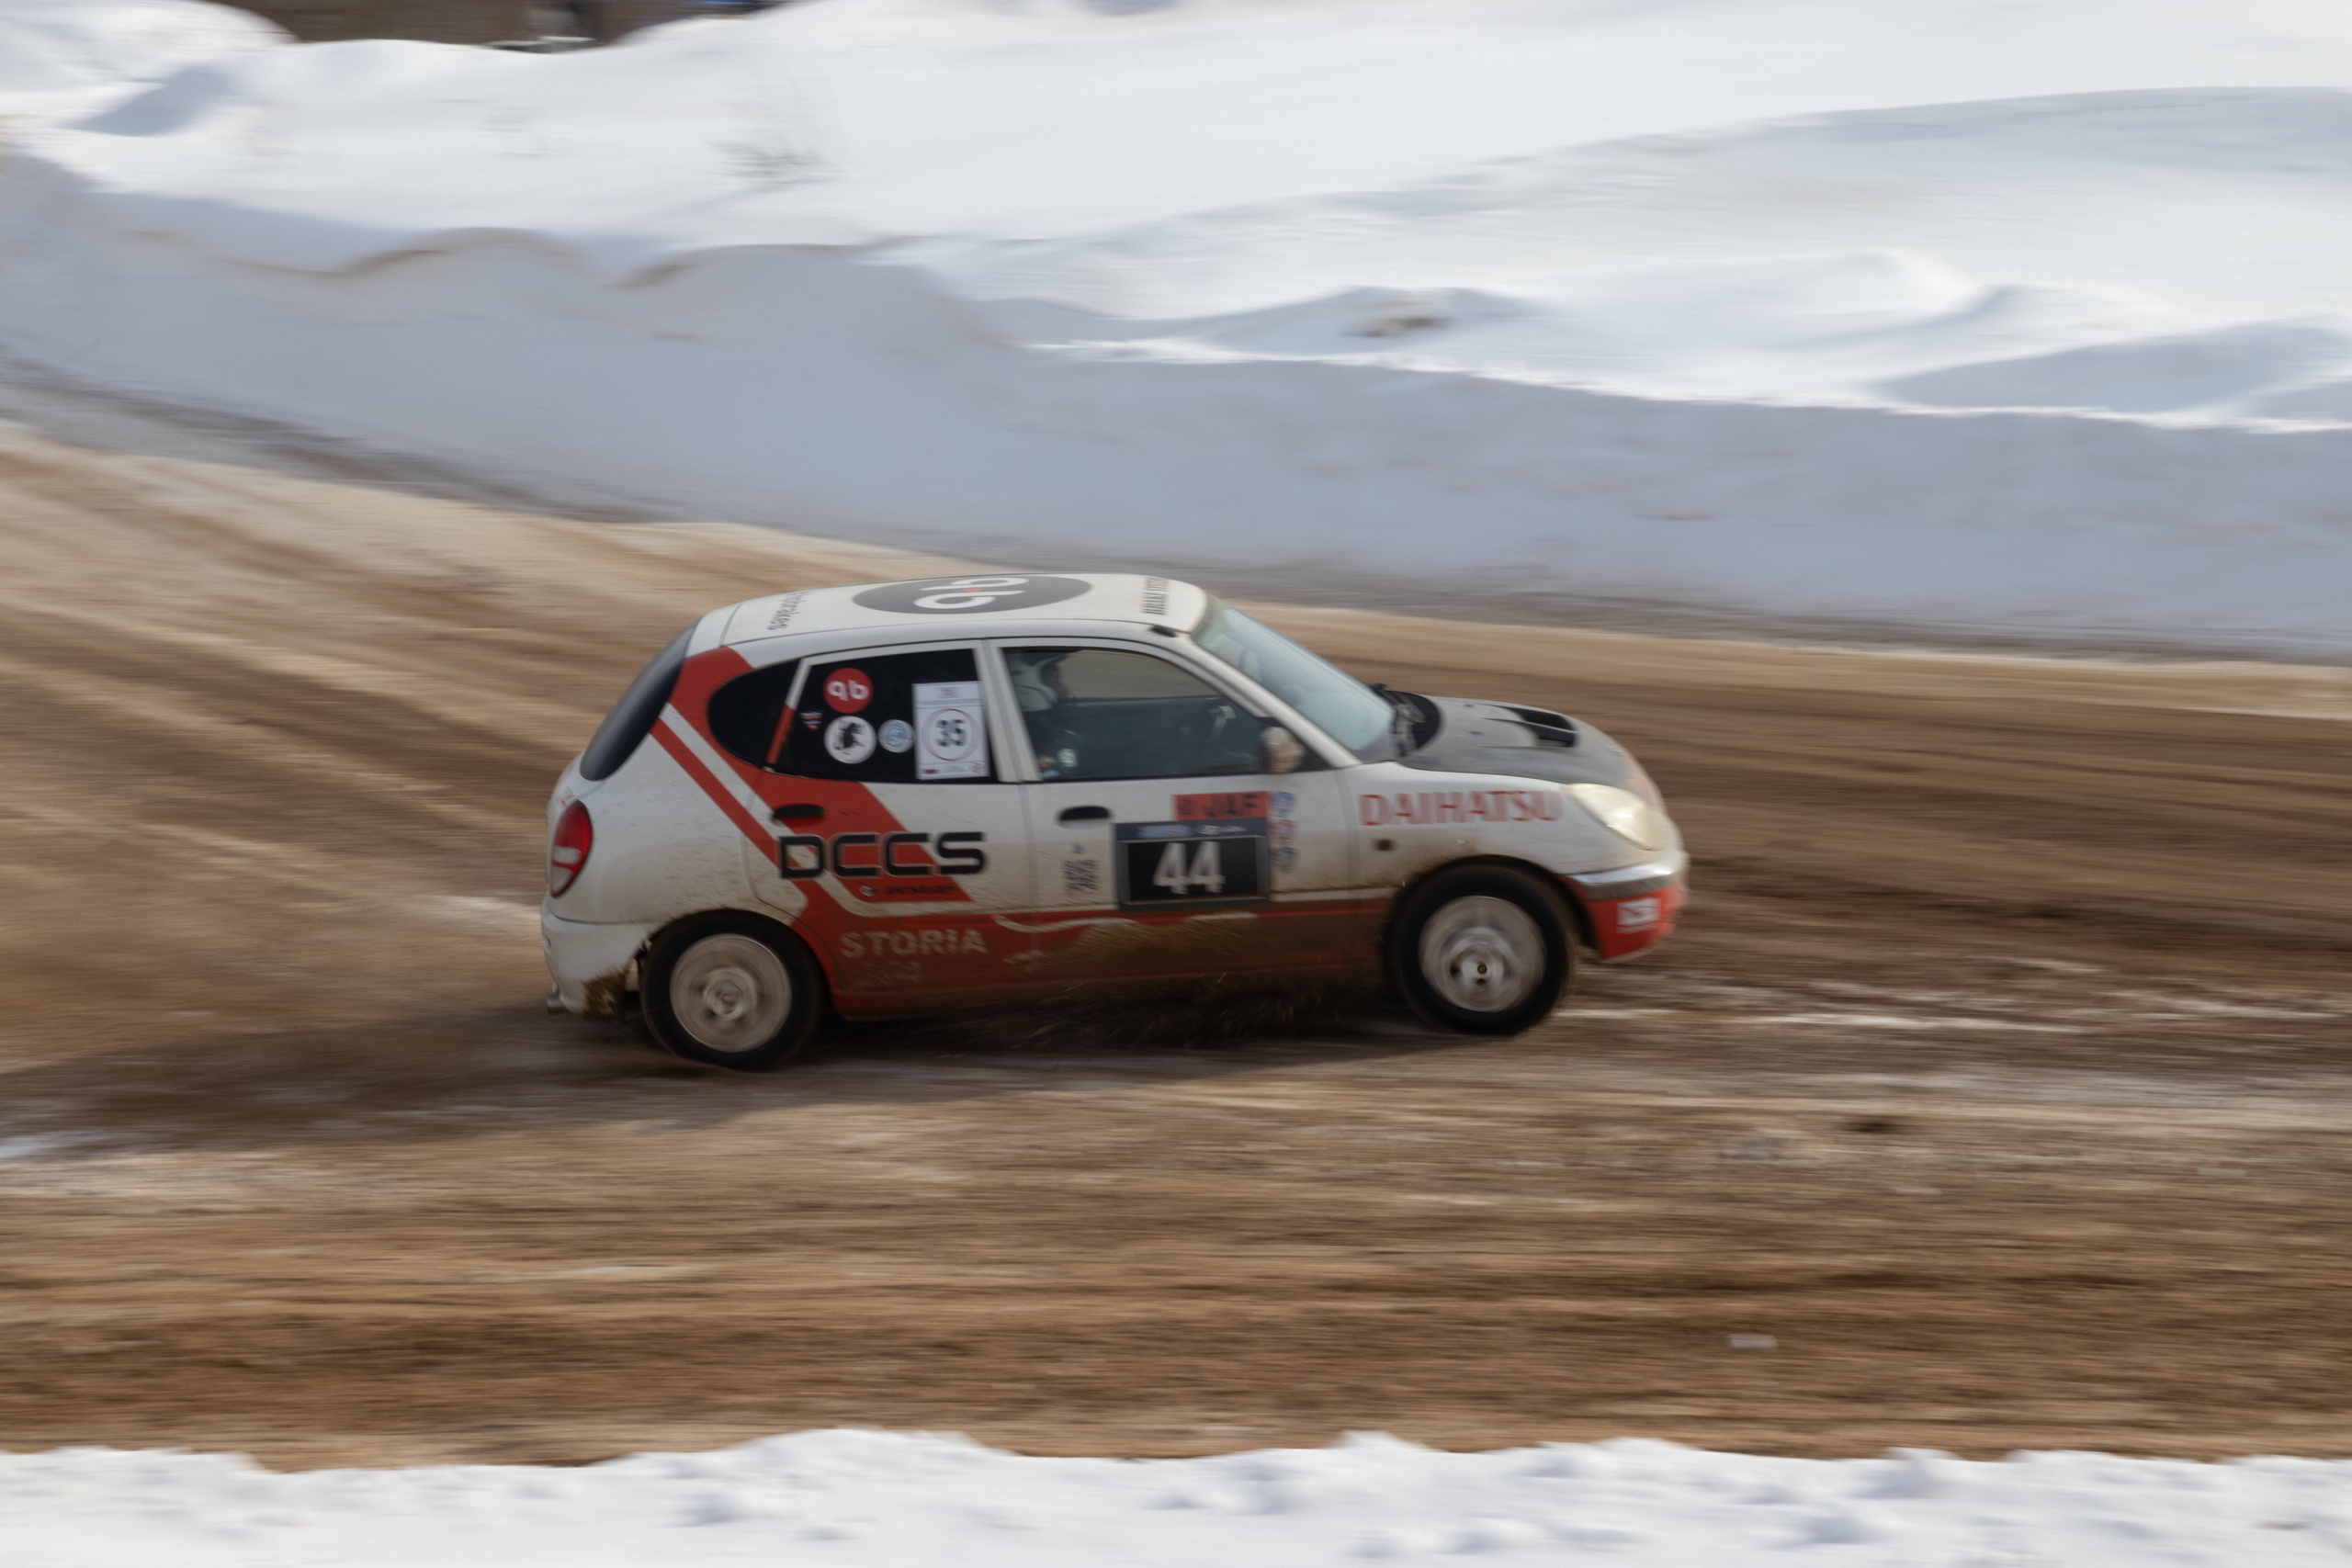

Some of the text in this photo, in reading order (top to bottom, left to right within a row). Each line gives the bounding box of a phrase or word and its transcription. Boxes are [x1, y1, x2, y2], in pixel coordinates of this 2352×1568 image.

[936, 719, 967, 748] 35
[1359, 790, 1563, 826] DAIHATSU
[777, 831, 987, 878] DCCS
[1152, 840, 1227, 895] 44
